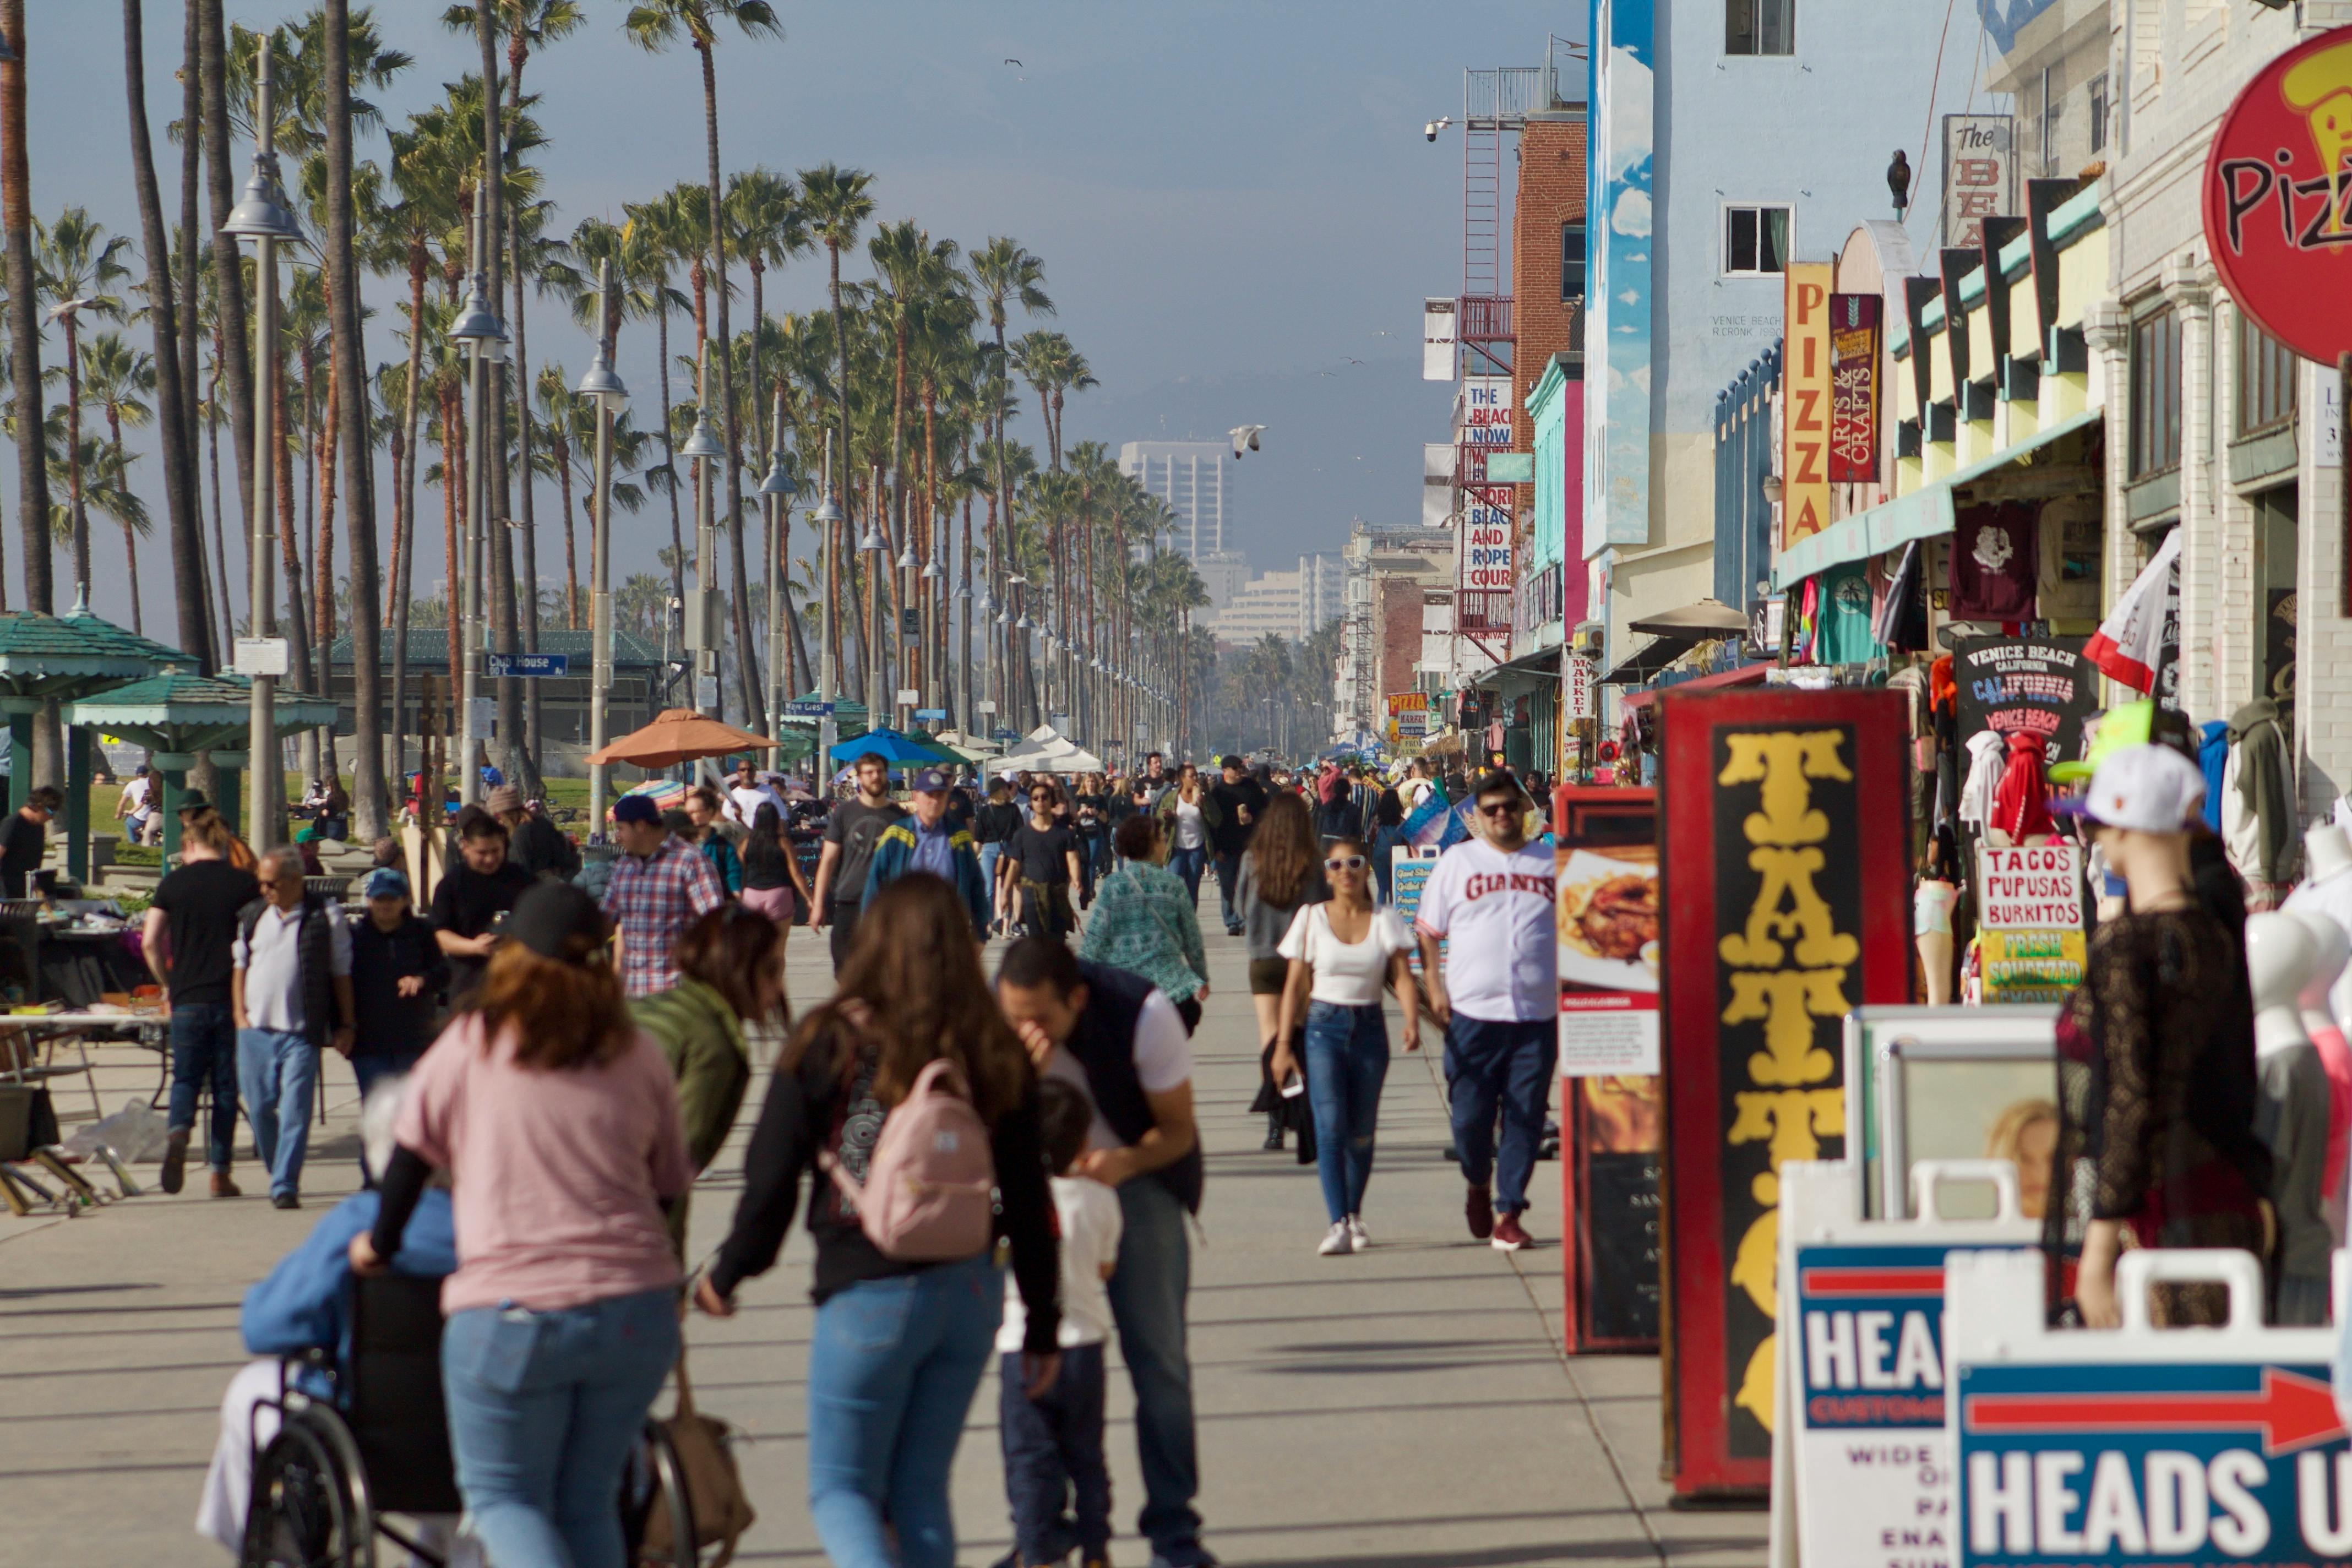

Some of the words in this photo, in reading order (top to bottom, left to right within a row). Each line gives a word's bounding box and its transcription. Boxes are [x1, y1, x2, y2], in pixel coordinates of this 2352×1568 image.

[1956, 123, 1994, 150] The
[1834, 368, 1852, 389] &
[1471, 389, 1498, 404] THE
[1793, 283, 1823, 535] PIZZA
[1851, 367, 1871, 465] CRAFTS
[1833, 395, 1852, 460] ARTS
[1472, 529, 1504, 545] AND
[488, 655, 511, 667] Club
[516, 655, 549, 668] House
[1967, 645, 2024, 667] VENICE
[2028, 645, 2077, 668] BEACH
[1995, 660, 2048, 673] CALIFORNIA
[554, 666, 564, 675] Av
[1572, 659, 1586, 715] MARKET
[1973, 673, 2073, 702] CALIFORNIA
[1389, 694, 1426, 712] PIZZA
[1400, 715, 1427, 723] MARKET
[1985, 709, 2024, 730] VENICE
[2025, 708, 2061, 732] BEACH
[1987, 849, 2070, 872] TACOS
[1988, 875, 2072, 898] PUPUSAS
[1989, 902, 2079, 924] BURRITOS
[2004, 933, 2063, 958] FRESH
[1988, 960, 2083, 986] SQUEEZED
[1847, 1445, 1932, 1465] WIDE
[1968, 1447, 2271, 1558] HEADS
